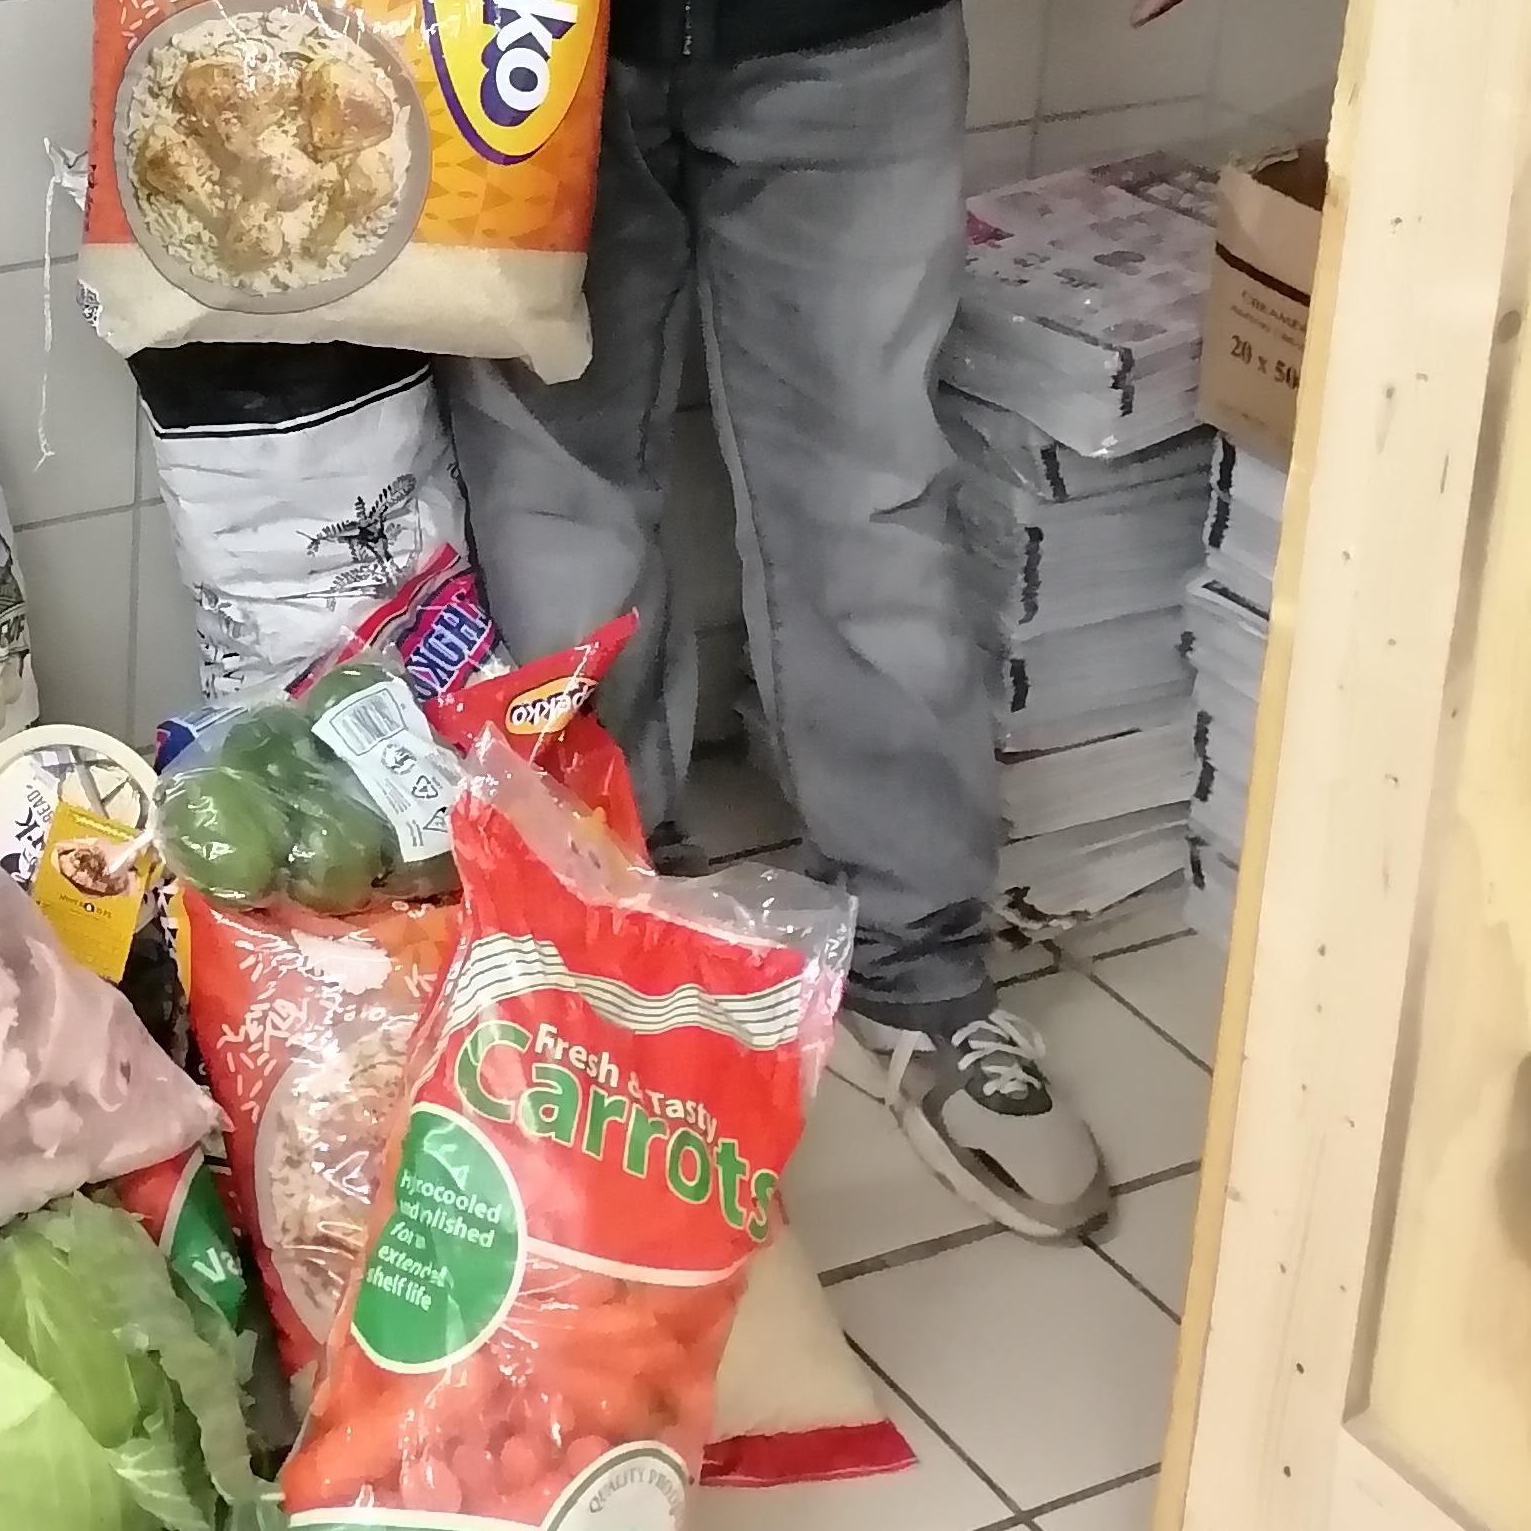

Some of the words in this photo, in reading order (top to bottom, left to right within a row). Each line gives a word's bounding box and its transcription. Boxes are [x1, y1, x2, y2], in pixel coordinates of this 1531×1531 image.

[1231, 335, 1253, 365] 20
[510, 681, 596, 725] pekko
[533, 1022, 620, 1090] Fresh
[645, 1089, 718, 1144] Tasty
[455, 1019, 780, 1243] Carrots
[366, 1265, 407, 1298] shelf
[405, 1280, 432, 1311] life
